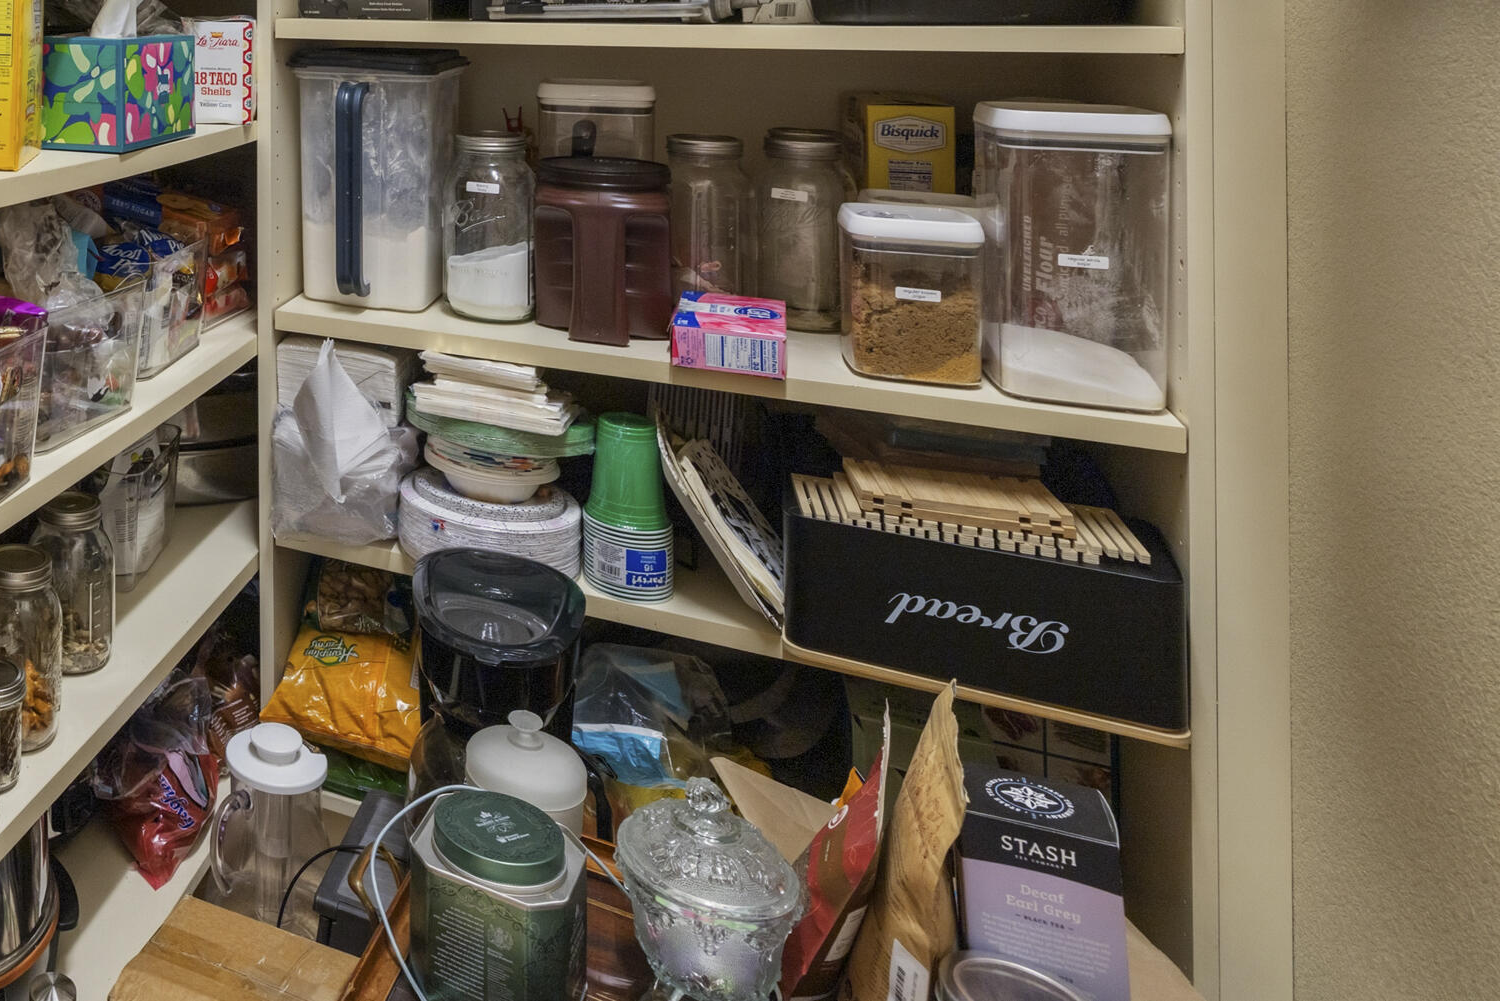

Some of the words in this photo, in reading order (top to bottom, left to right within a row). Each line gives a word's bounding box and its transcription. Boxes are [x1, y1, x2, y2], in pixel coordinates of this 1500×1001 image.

[196, 35, 207, 47] La
[210, 37, 238, 48] Tiara
[195, 72, 207, 85] 18
[209, 72, 237, 85] TACO
[201, 87, 231, 96] Shells
[881, 124, 940, 141] Bisquick
[112, 199, 129, 208] ZERO
[132, 204, 155, 217] SUGAR
[1036, 236, 1053, 292] Flour
[885, 592, 1069, 655] Bread
[1001, 835, 1077, 867] STASH
[1021, 885, 1065, 904] Decaf
[1006, 895, 1037, 912] Earl
[1044, 905, 1081, 923] Grey
[1023, 915, 1046, 925] BLACK
[1051, 920, 1065, 930] TEA
